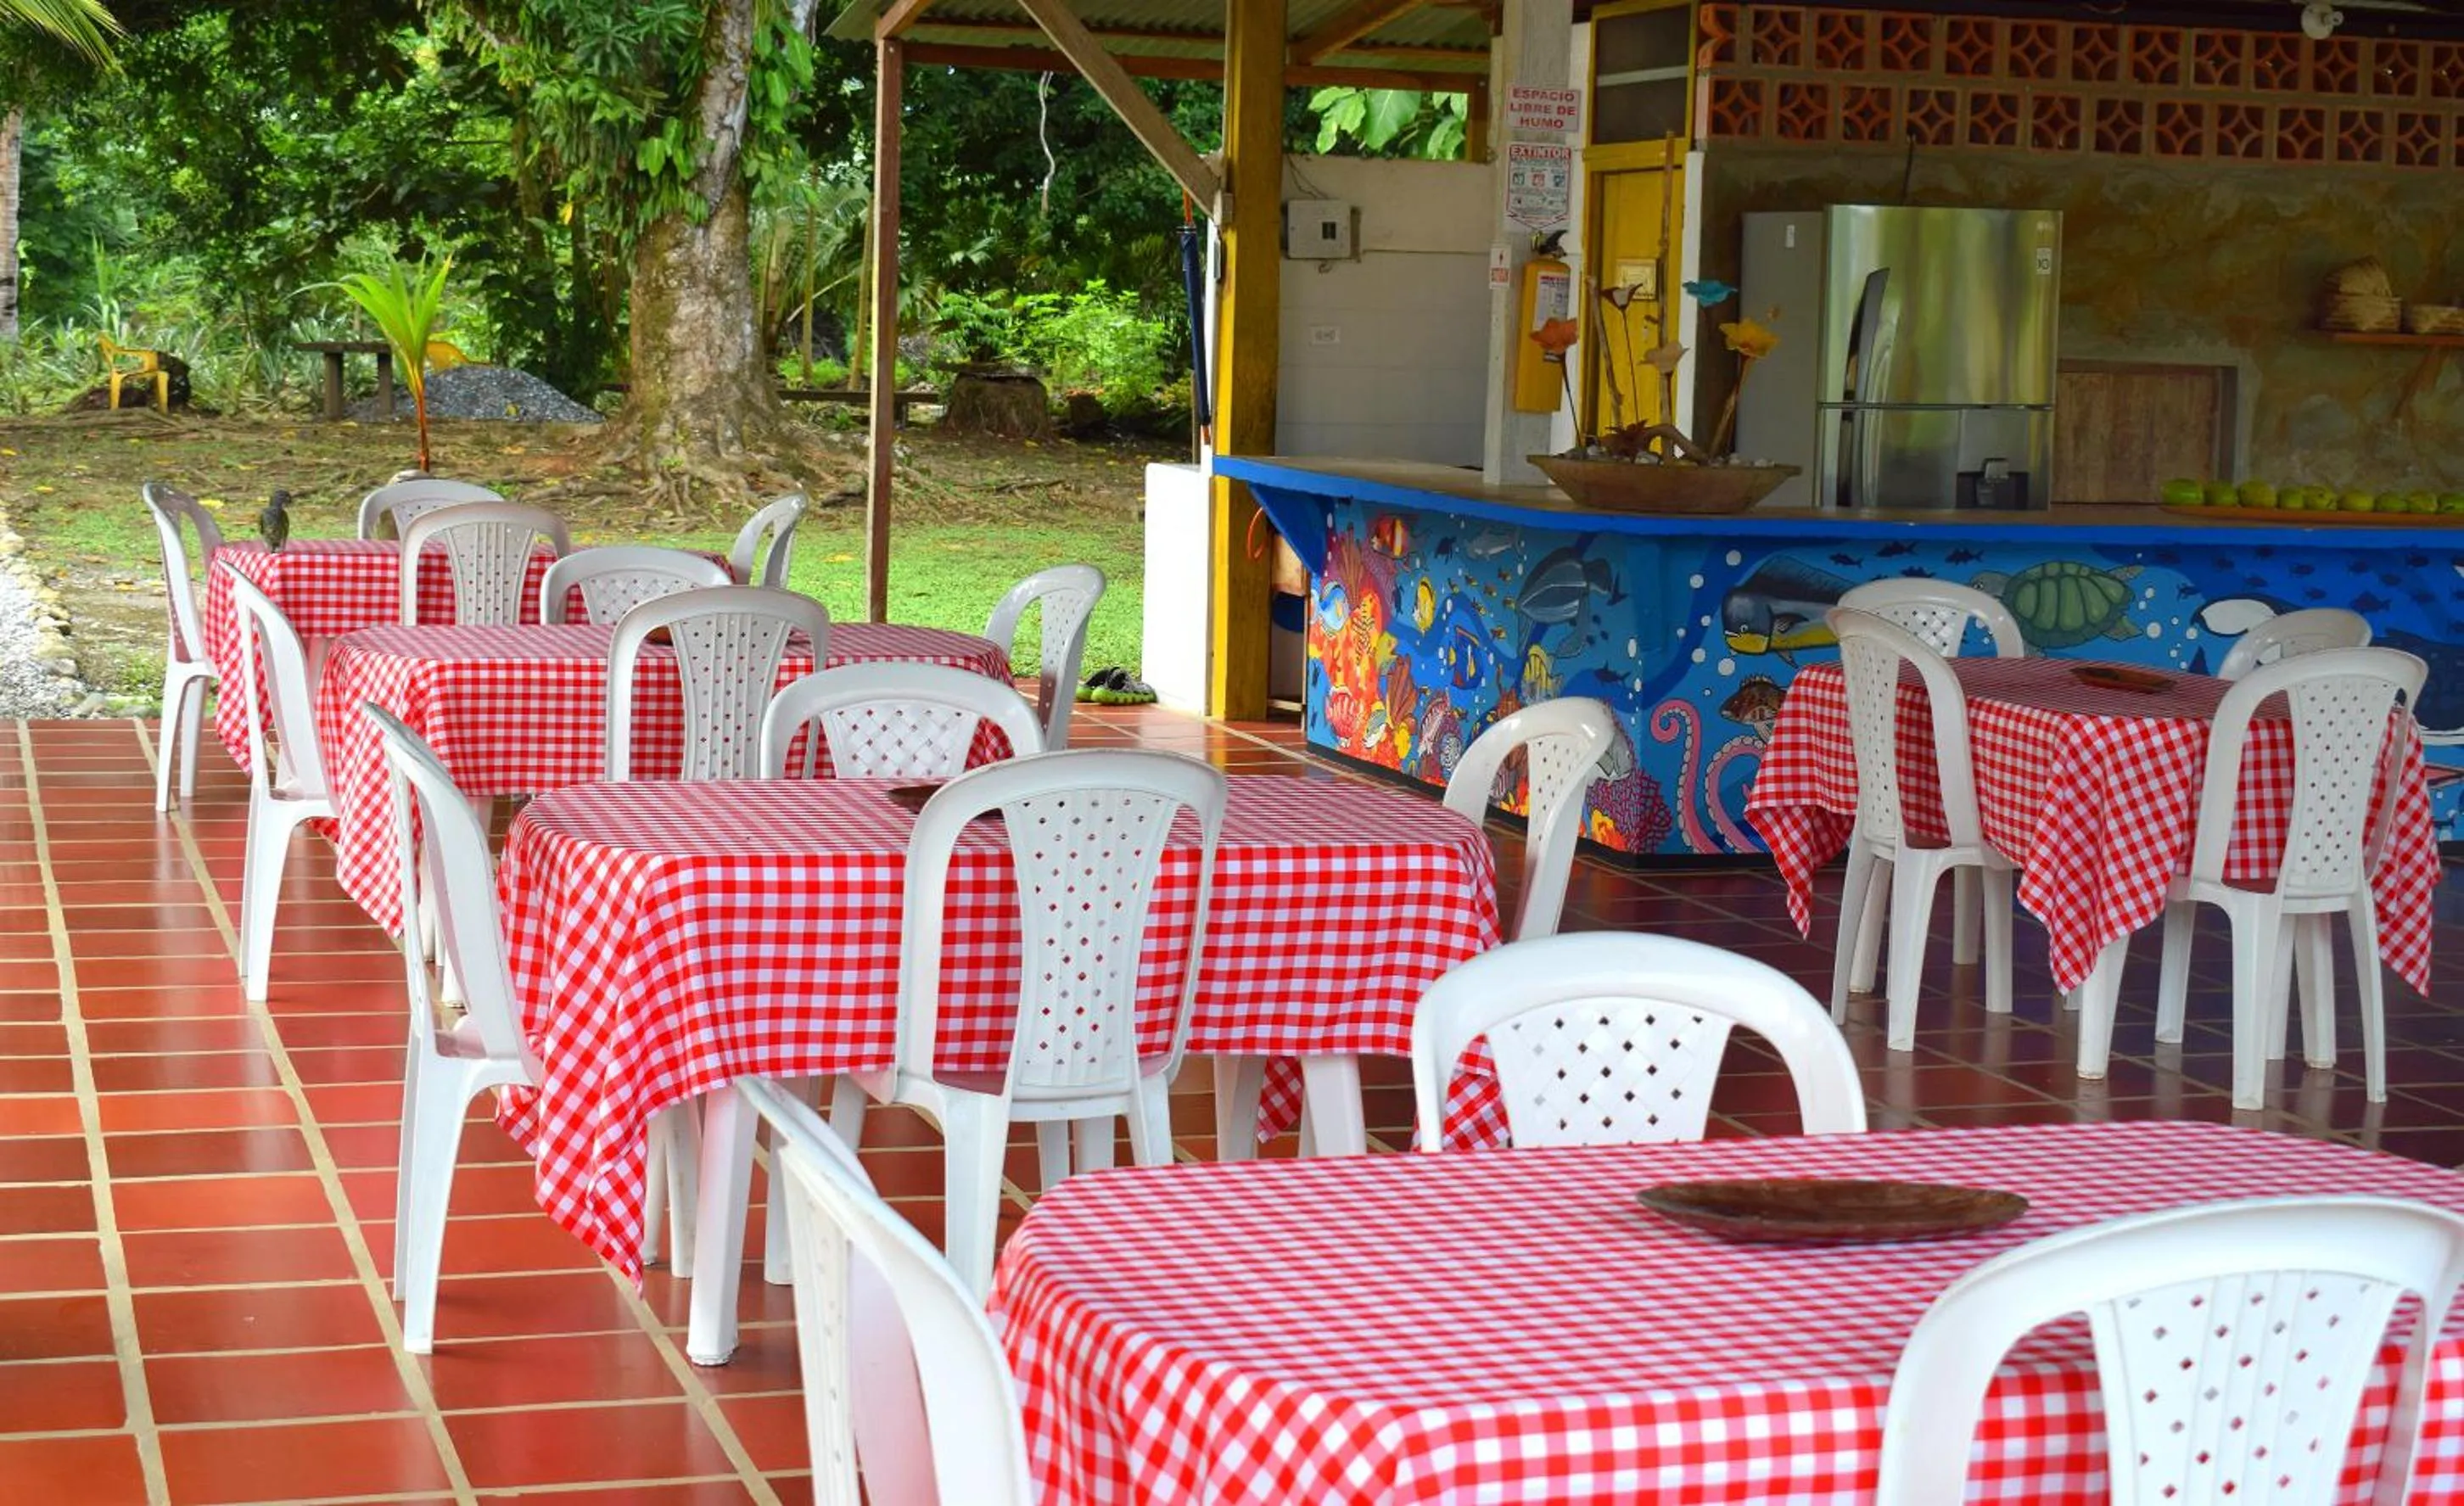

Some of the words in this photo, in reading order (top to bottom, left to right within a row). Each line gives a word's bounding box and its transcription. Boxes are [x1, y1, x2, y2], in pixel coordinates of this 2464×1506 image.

[1513, 88, 1575, 102] ESPACIO
[1510, 103, 1552, 114] LIBRE
[1557, 105, 1576, 115] DE
[1520, 117, 1564, 128] HUMO
[1512, 146, 1570, 160] EXTINTOR
